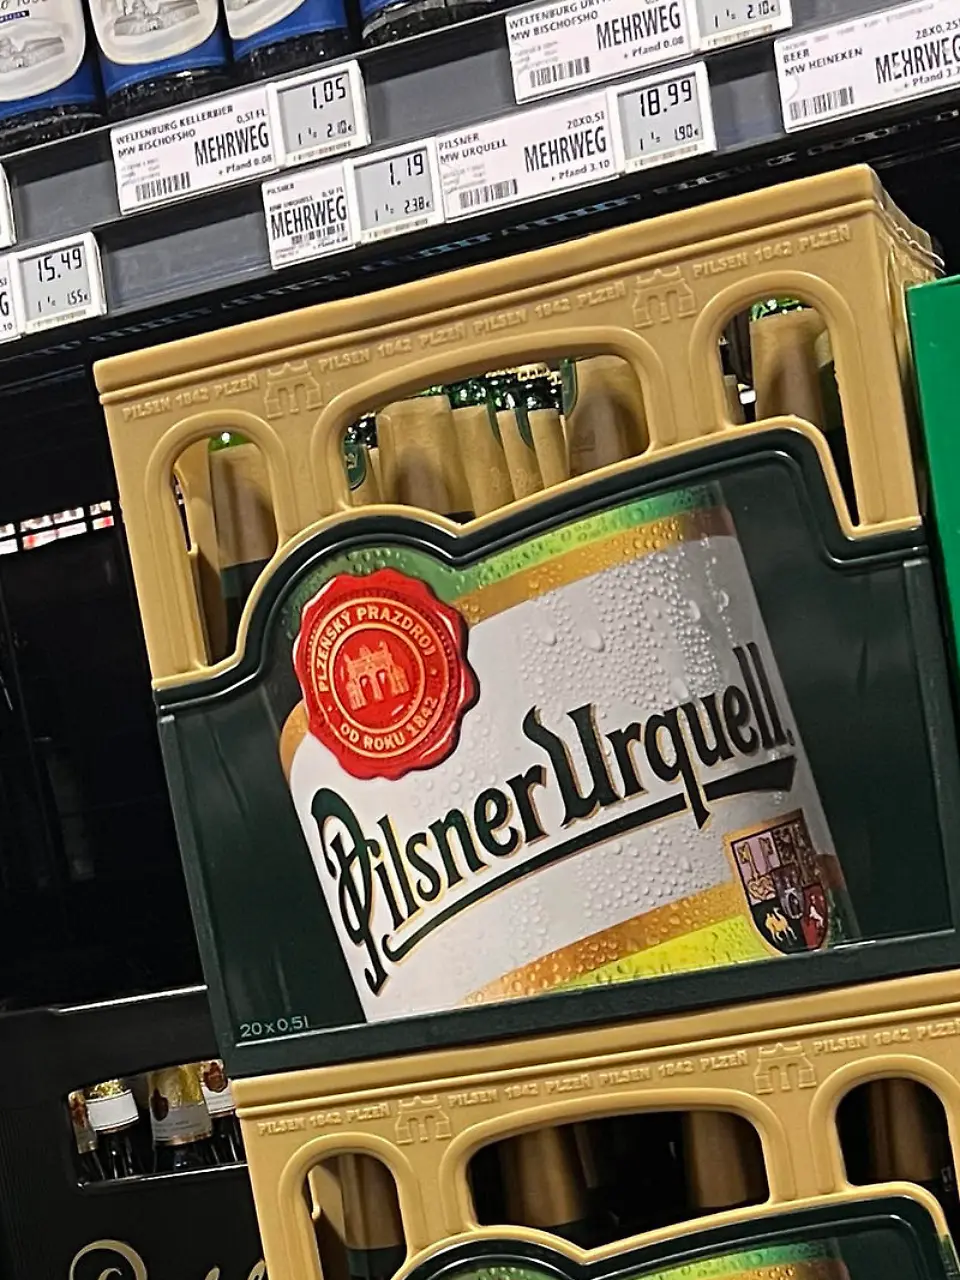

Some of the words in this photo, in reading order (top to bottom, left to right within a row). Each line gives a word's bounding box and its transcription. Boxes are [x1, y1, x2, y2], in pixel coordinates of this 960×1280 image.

[596, 2, 682, 50] MEHRWEG
[783, 48, 809, 64] BEER
[785, 64, 806, 77] MW
[808, 47, 863, 70] HEINEKEN
[875, 34, 960, 84] MEHRWEG
[311, 77, 346, 110] 1.05
[640, 79, 692, 117] 18.99
[116, 120, 178, 146] WELTENBURG
[193, 122, 270, 168] MEHRWEG
[439, 132, 480, 150] PILSNER
[461, 138, 508, 158] URQUELL
[524, 126, 607, 173] MEHRWEG
[389, 153, 424, 186] 1.19
[270, 195, 347, 240] MEHRWEG
[37, 248, 82, 283] 15.49
[356, 604, 437, 656] PRAZDROJ
[340, 724, 360, 743] OD
[364, 733, 405, 751] ROKU
[406, 696, 439, 737] 1842
[310, 762, 552, 997] Pilsner
[240, 1021, 262, 1038] 20
[265, 1021, 275, 1034] x
